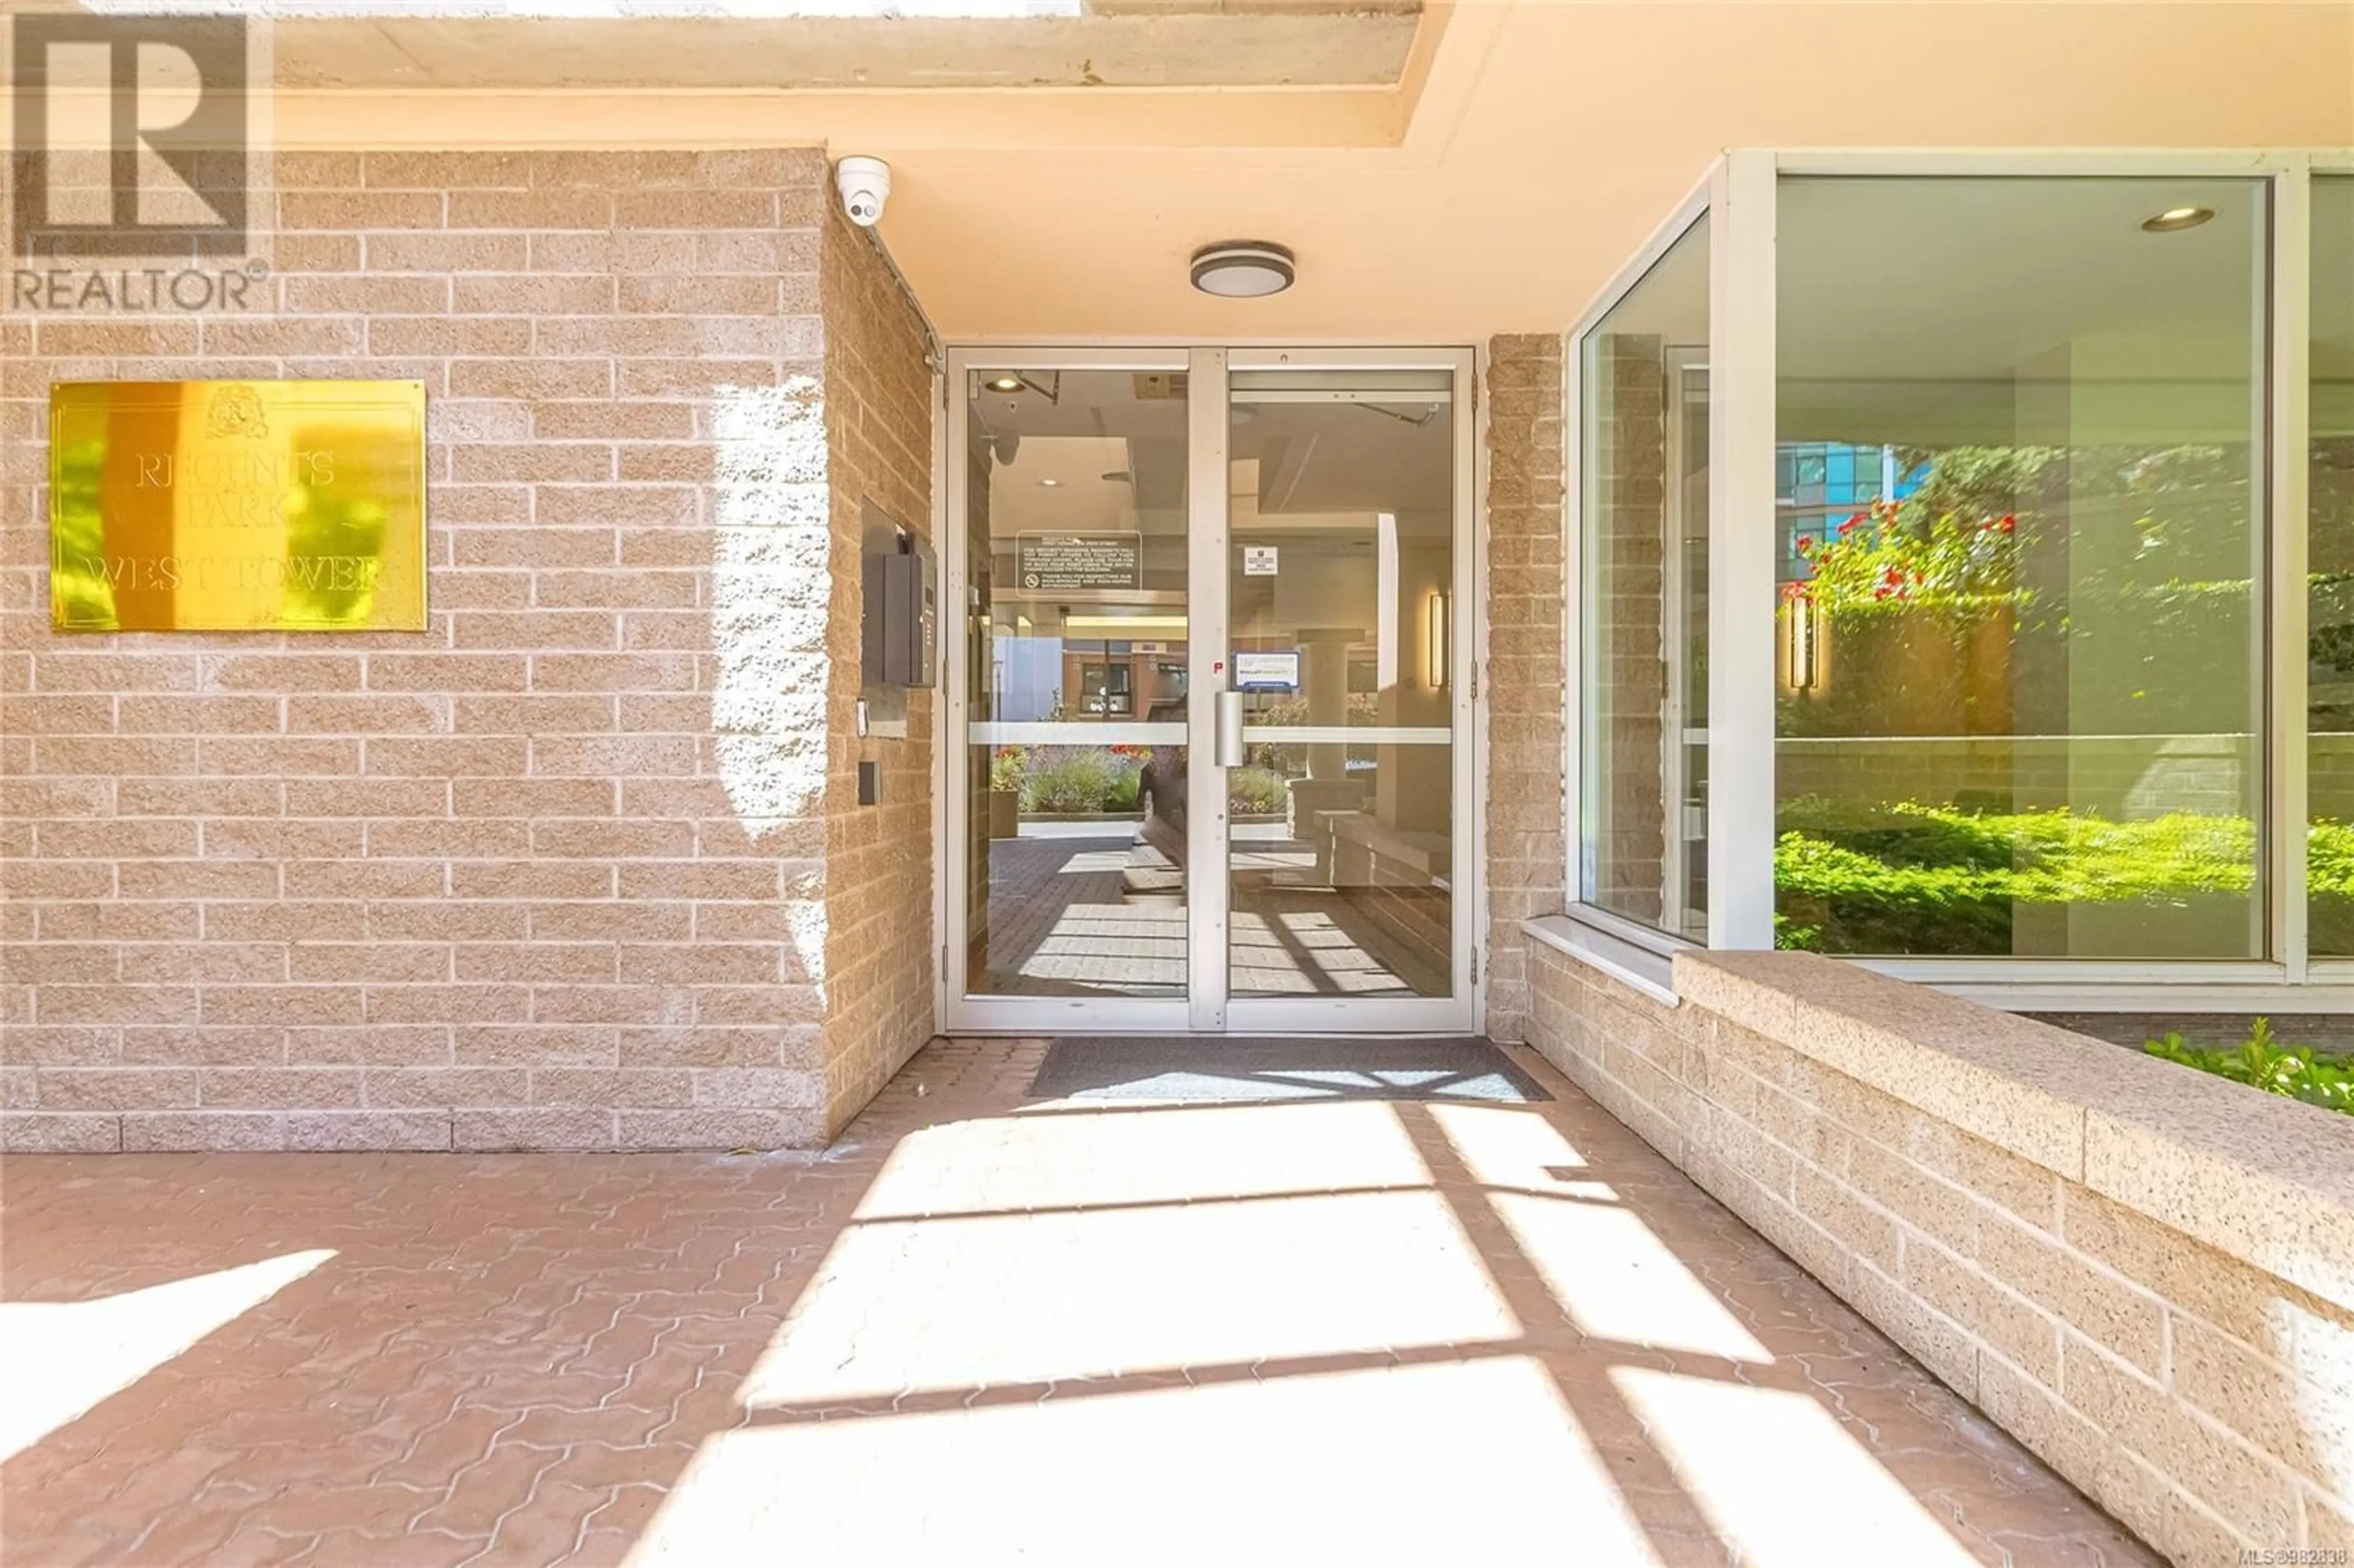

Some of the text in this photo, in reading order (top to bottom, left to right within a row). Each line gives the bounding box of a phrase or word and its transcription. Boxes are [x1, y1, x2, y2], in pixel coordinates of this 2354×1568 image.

[187, 492, 295, 528] PARK
[84, 555, 397, 592] WEST TOWER
